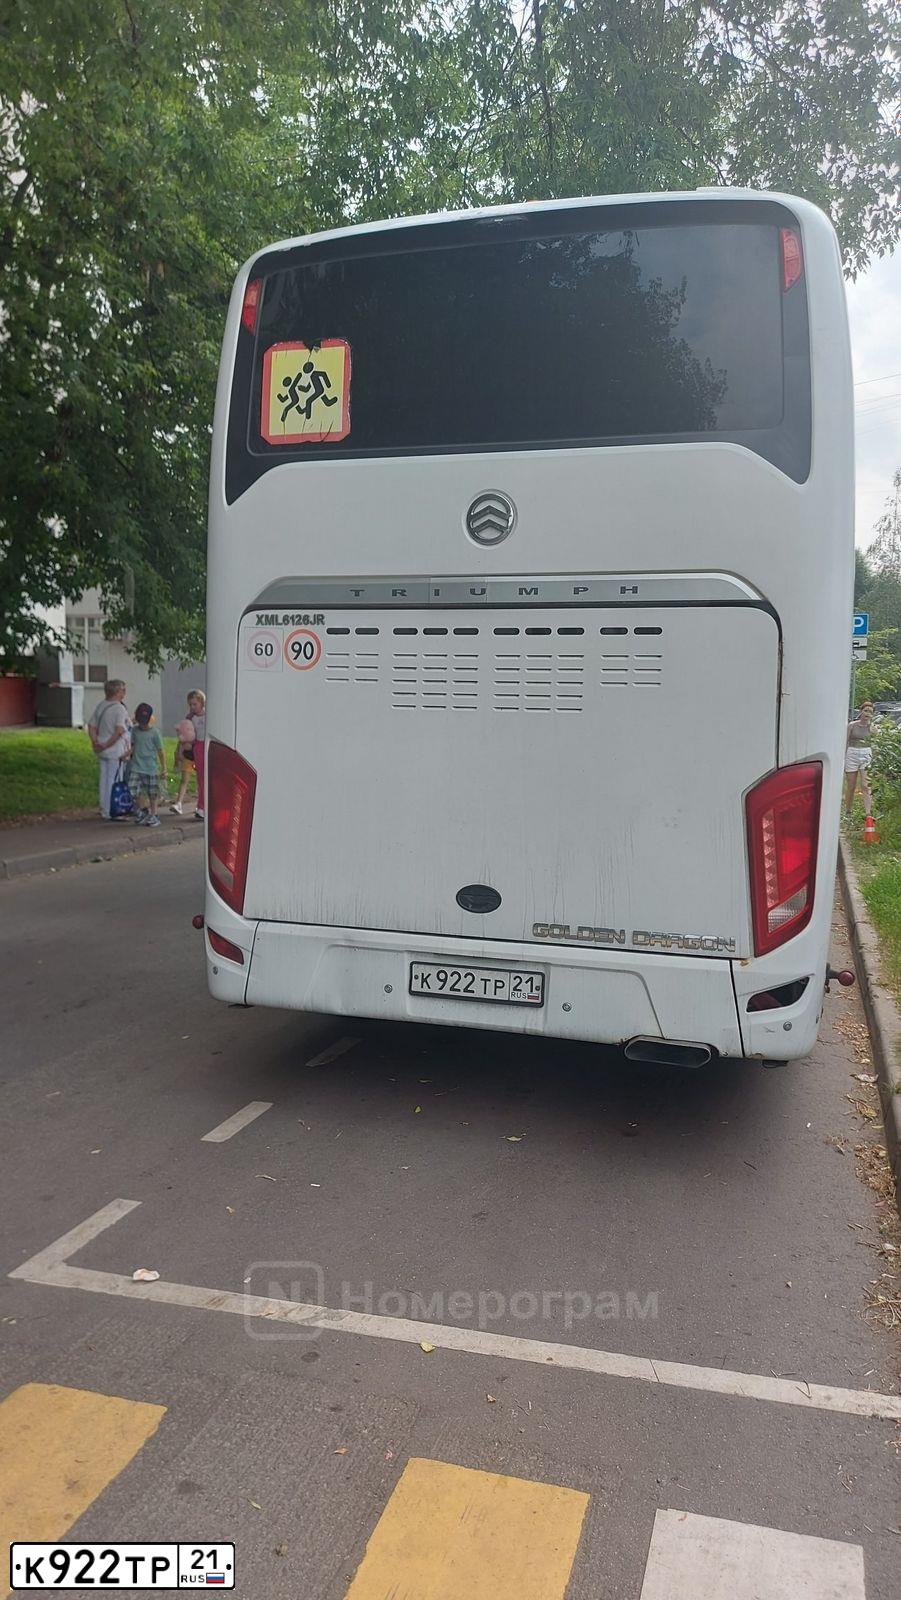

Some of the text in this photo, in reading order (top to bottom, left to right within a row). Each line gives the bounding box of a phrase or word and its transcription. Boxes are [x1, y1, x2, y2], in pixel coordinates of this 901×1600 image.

[350, 585, 638, 597] TRIUMPH
[255, 614, 325, 626] XML6126JR
[254, 642, 274, 656] 60
[291, 641, 314, 660] 90
[532, 922, 736, 952] GOLDEN DRAGON
[512, 975, 534, 993] 21
[510, 991, 527, 999] RUS
